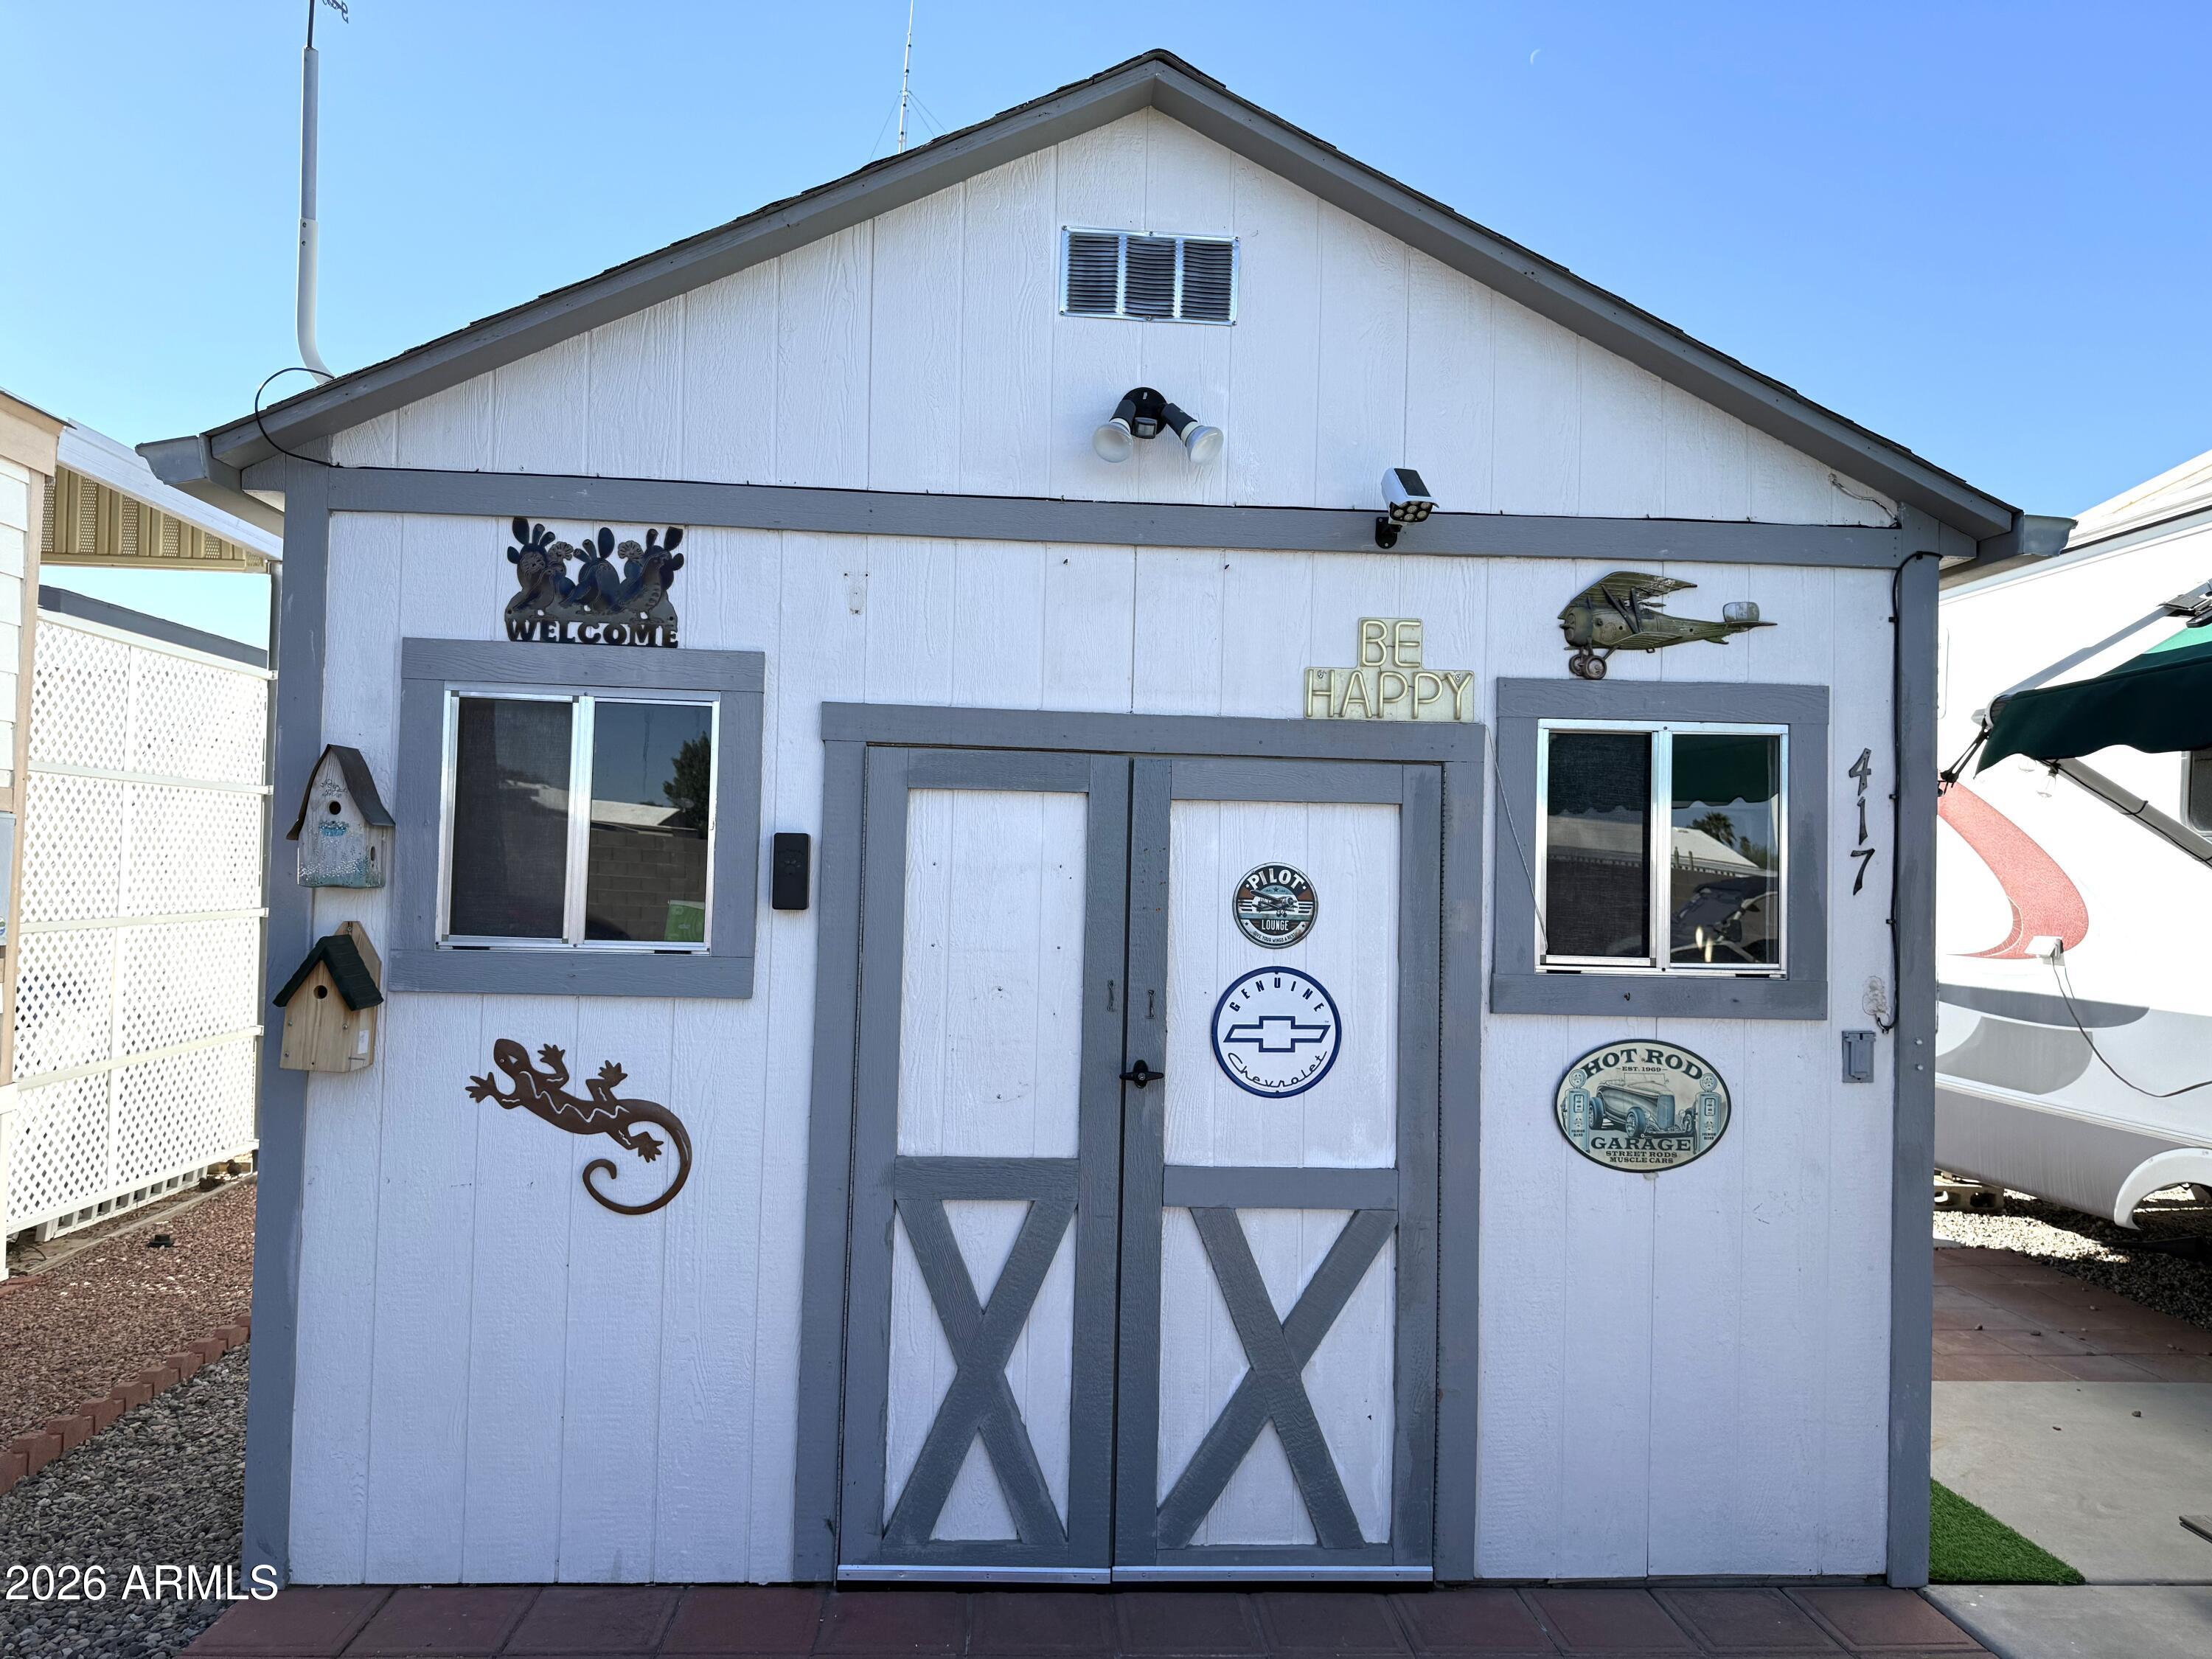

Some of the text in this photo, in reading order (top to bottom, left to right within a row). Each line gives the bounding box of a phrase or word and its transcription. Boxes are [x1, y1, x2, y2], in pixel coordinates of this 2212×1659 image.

[507, 619, 678, 648] WELCOME
[1362, 619, 1422, 667] BE
[1307, 669, 1473, 720] HAPPY
[1848, 748, 1876, 896] 417
[1247, 868, 1305, 890] PILOT
[1262, 919, 1289, 931] LOUNGE
[1229, 978, 1324, 1012] GENUINE
[1228, 1051, 1327, 1088] Chevrolet
[1580, 1048, 1703, 1080] HOT ROD
[1590, 1137, 1691, 1151] GARAGE
